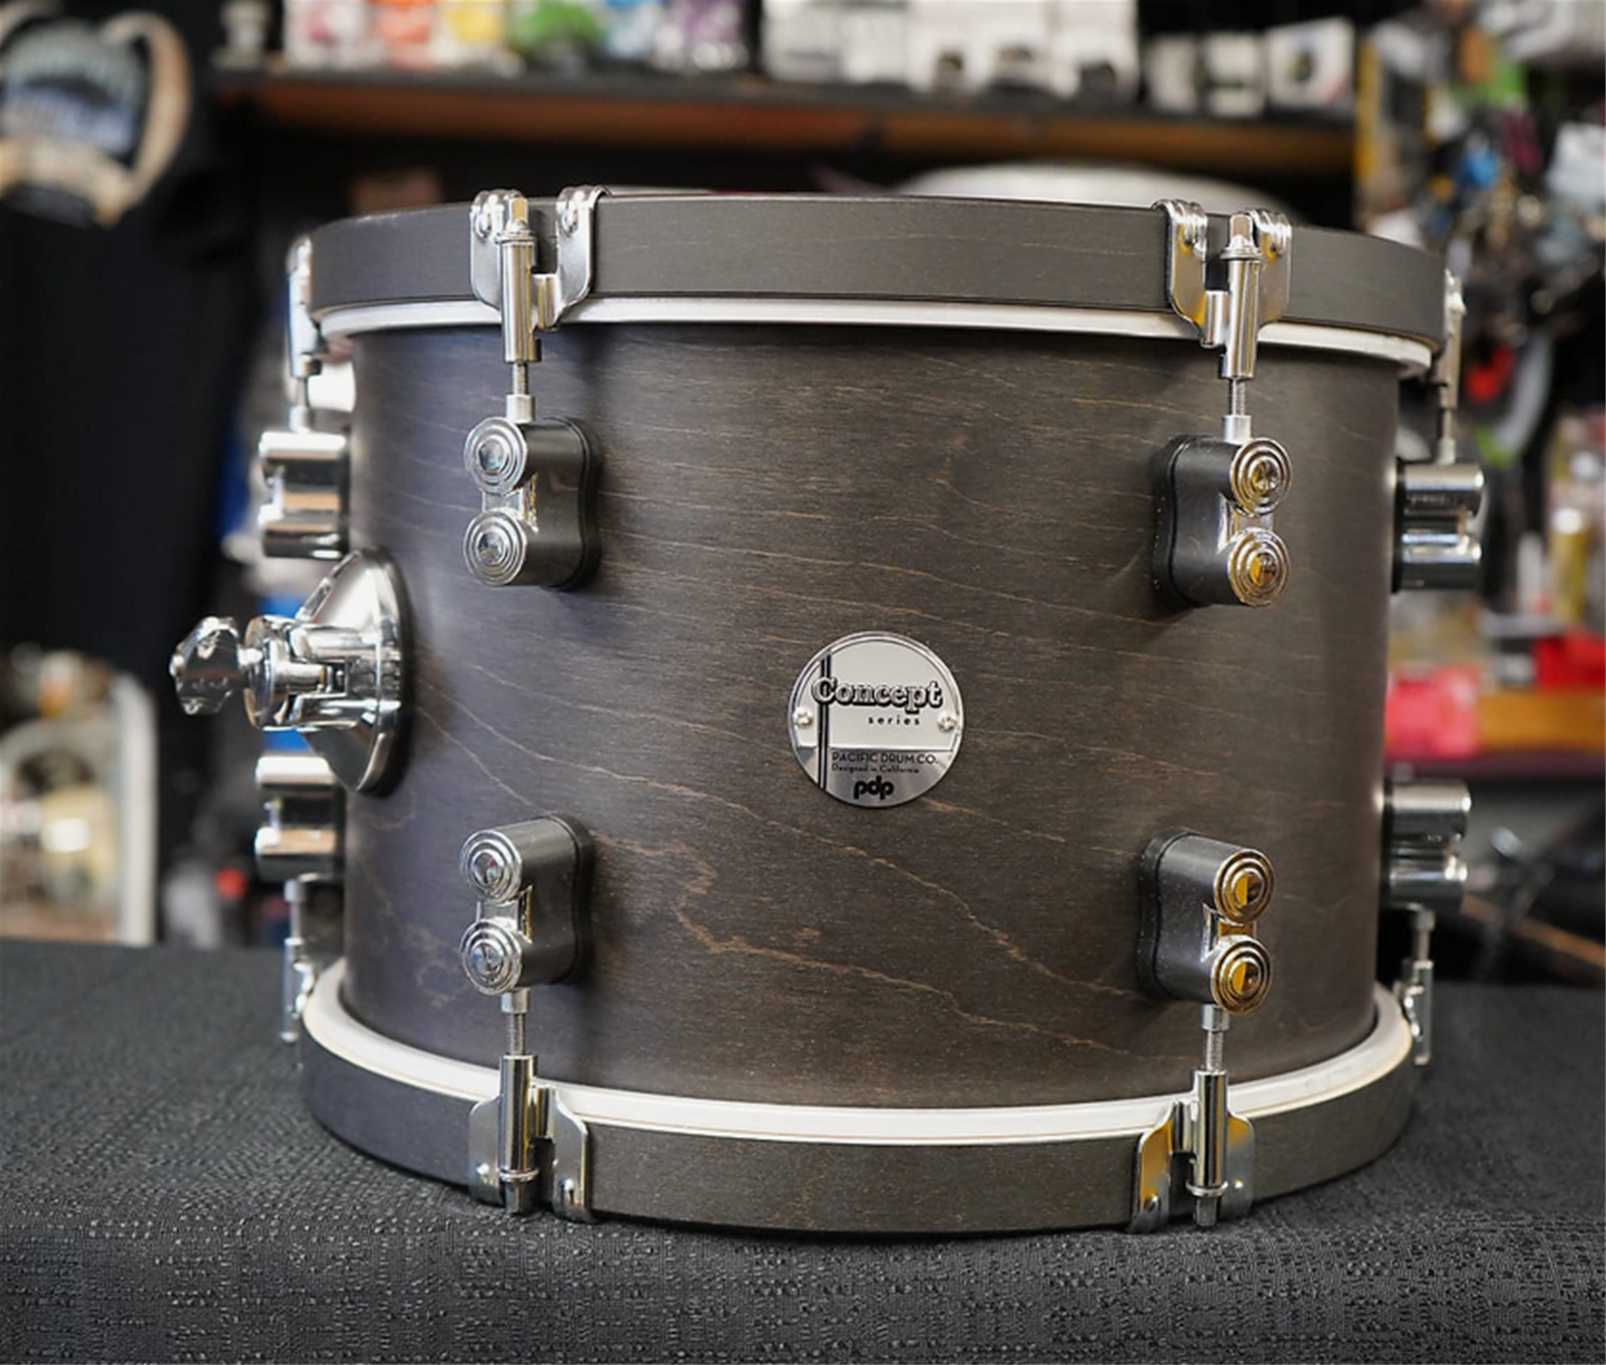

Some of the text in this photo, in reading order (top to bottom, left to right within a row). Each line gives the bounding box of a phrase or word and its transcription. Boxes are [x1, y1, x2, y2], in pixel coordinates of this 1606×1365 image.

[811, 677, 943, 714] Concept
[868, 716, 920, 725] series
[832, 752, 939, 765] PACIFIC DRUM CO.
[854, 775, 894, 799] pdp
